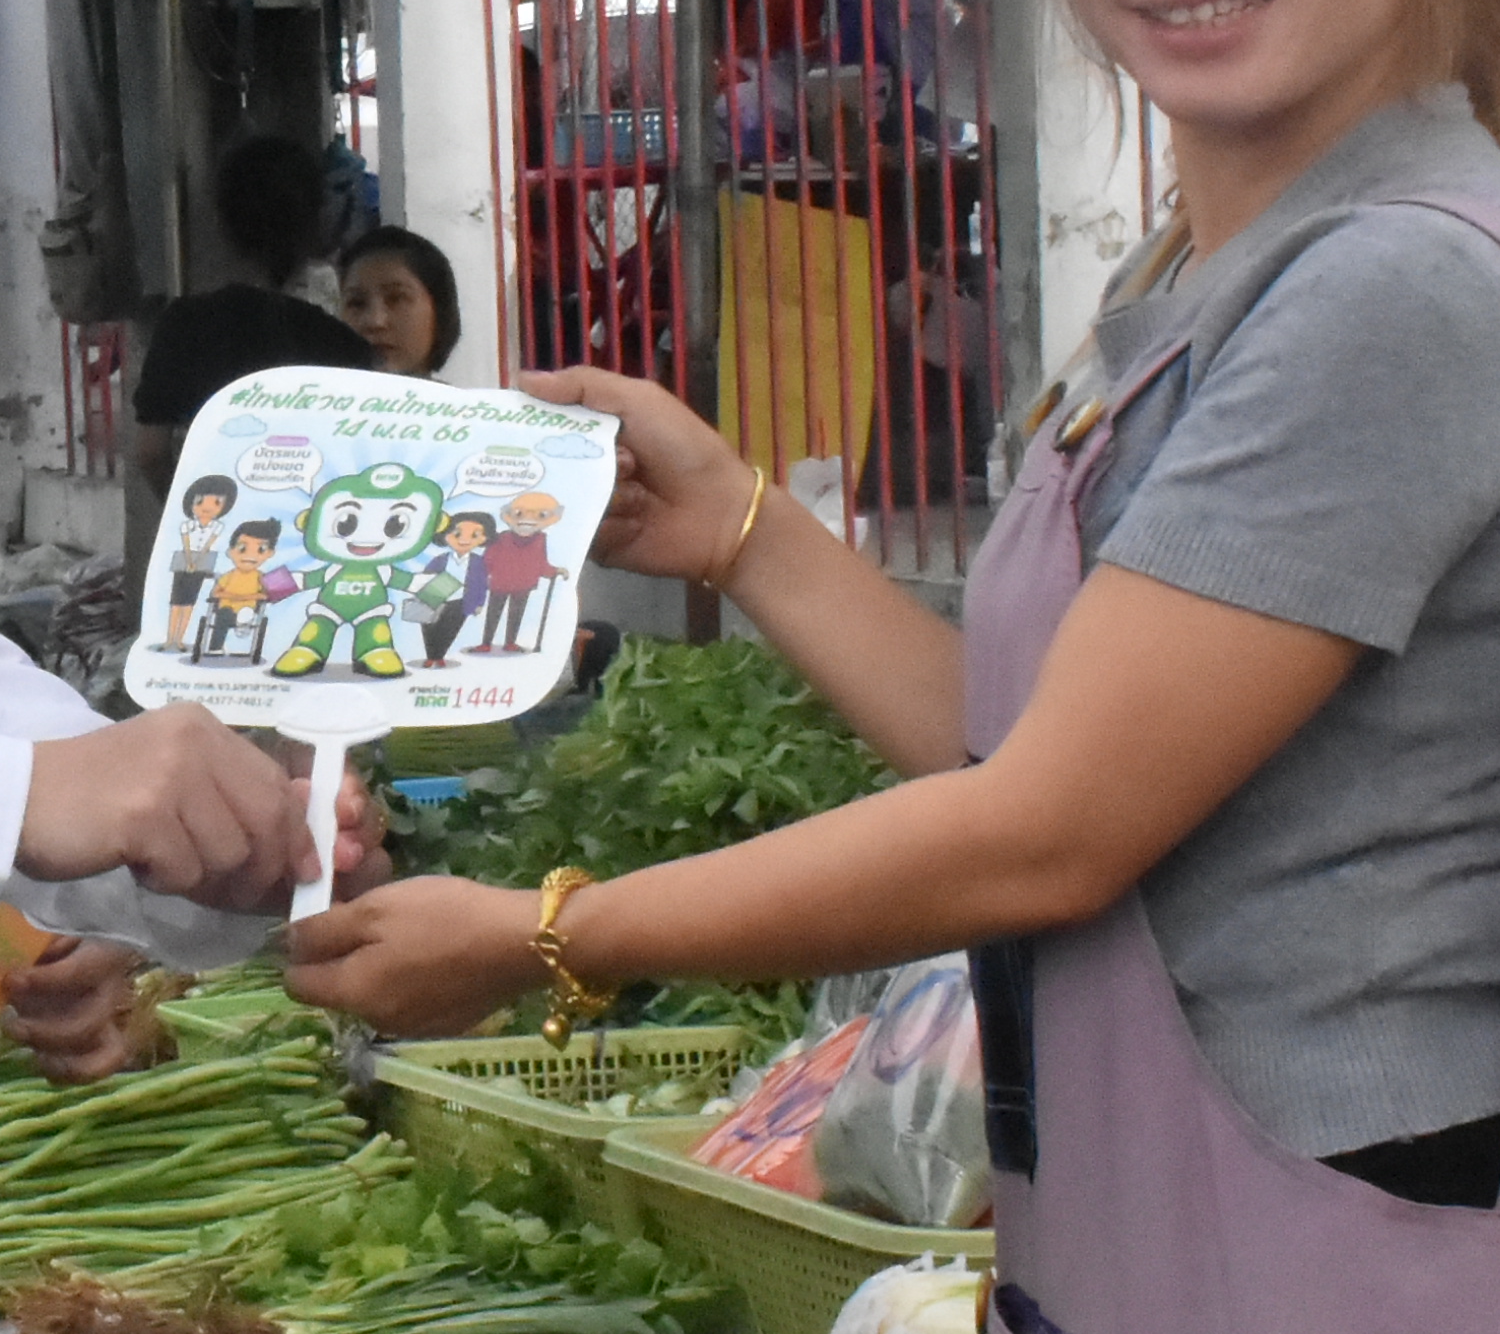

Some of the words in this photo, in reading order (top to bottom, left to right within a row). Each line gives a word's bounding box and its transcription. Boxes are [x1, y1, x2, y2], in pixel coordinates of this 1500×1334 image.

[332, 418, 365, 438] 14
[432, 424, 470, 443] 66
[334, 581, 377, 595] ECT
[452, 687, 514, 708] 1444
